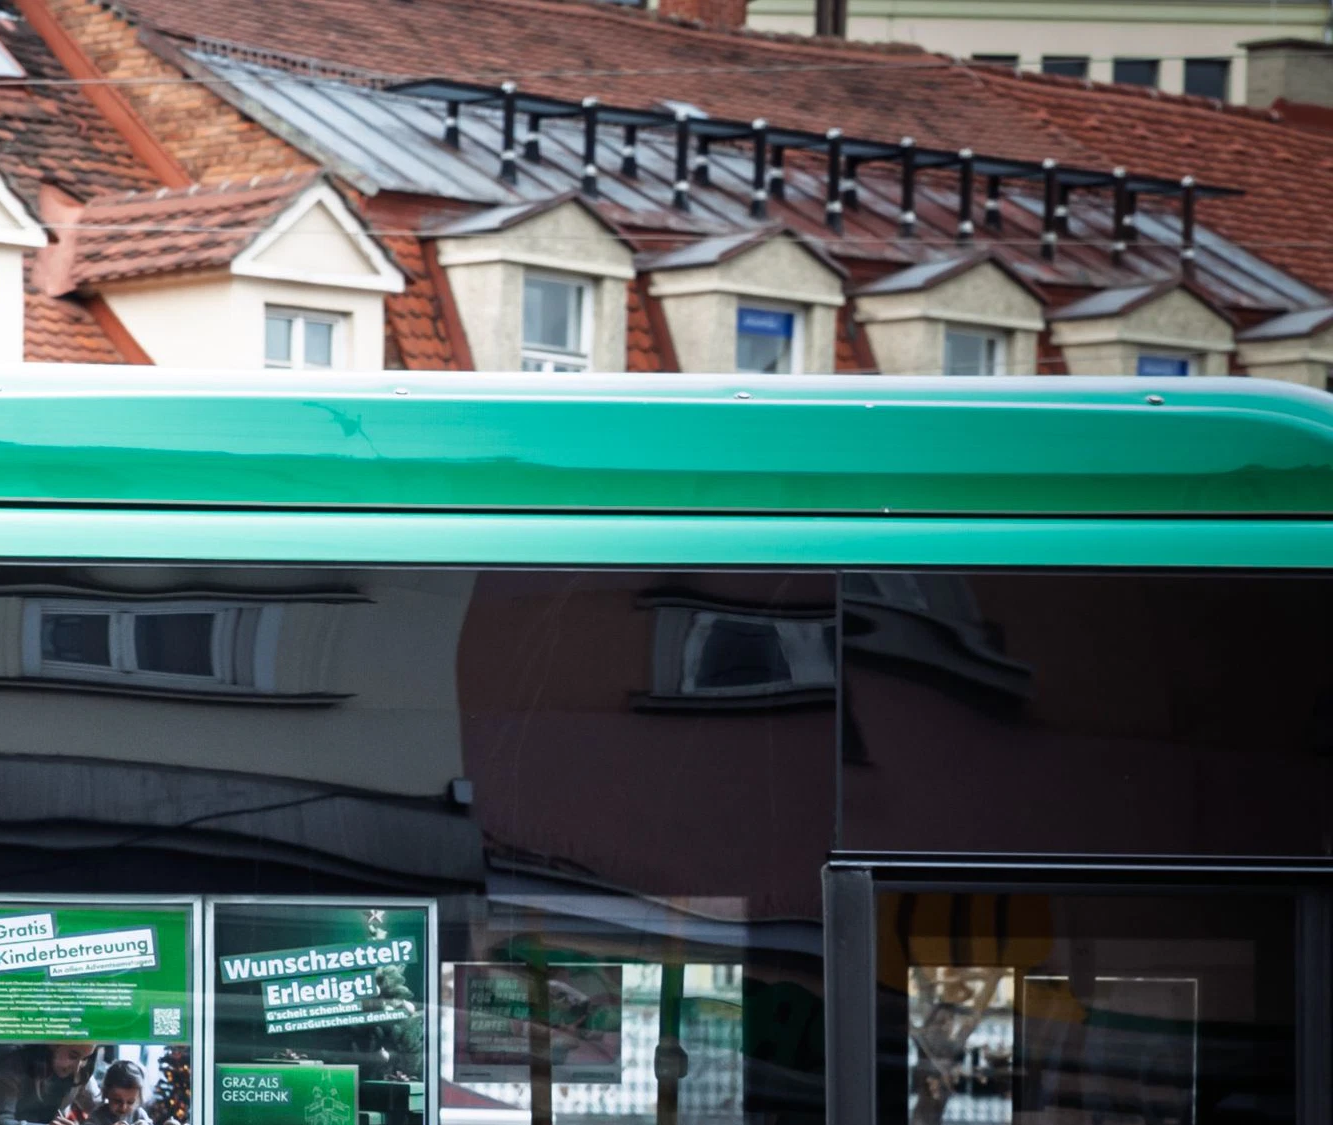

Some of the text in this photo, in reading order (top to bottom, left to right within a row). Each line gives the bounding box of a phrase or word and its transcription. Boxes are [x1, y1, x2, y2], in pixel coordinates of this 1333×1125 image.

[223, 940, 413, 980] Wunschzettel?
[52, 966, 64, 975] An
[266, 974, 373, 1006] Erledigt!
[266, 1003, 362, 1022] G'scheit schenken.
[267, 1010, 408, 1034] An GrazGutscheine denken.
[222, 1076, 279, 1089] GRAZ ALS
[221, 1089, 289, 1102] GESCHENK
